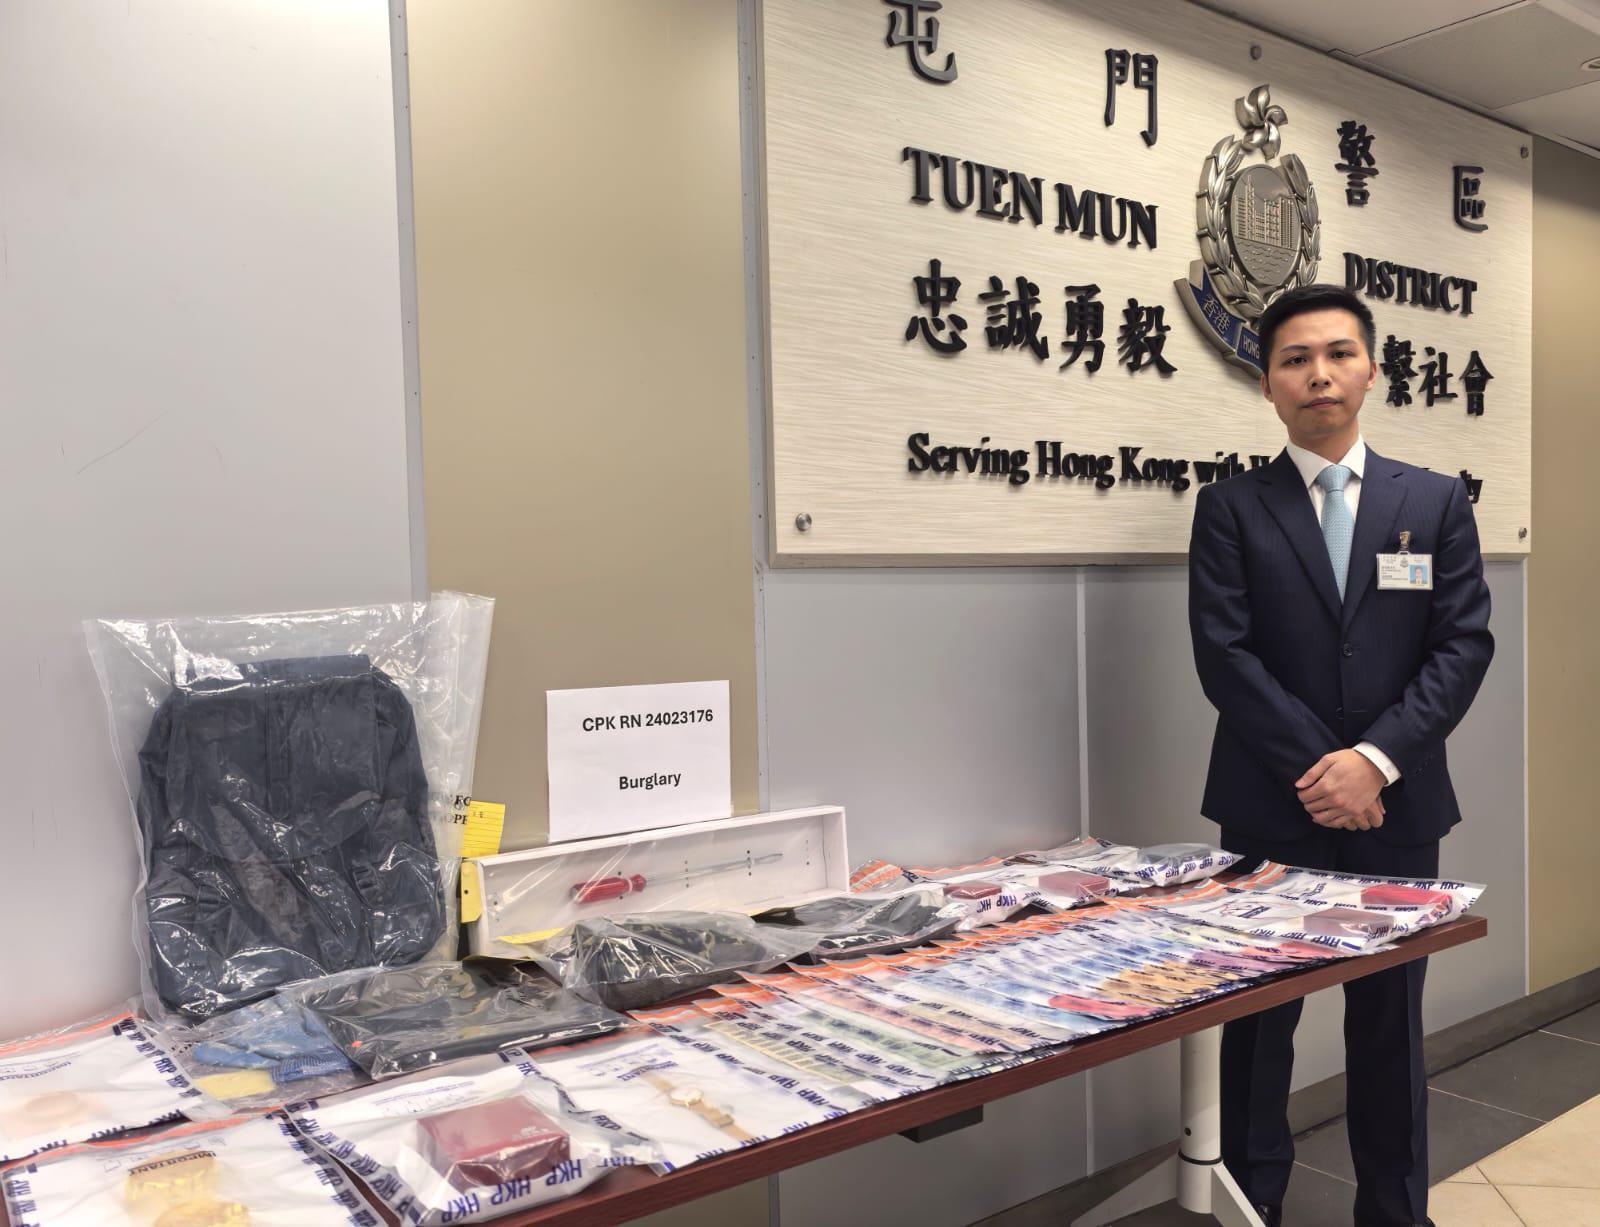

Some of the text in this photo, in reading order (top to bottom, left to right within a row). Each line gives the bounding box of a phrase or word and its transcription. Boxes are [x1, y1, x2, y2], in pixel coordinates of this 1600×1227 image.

[902, 146, 1478, 315] TUEN MUN DISTRICT
[905, 258, 1178, 374] 忠誠勇毅
[1243, 334, 1261, 360] HONG
[907, 432, 1030, 486] Serving
[1035, 440, 1116, 490] Hong
[1118, 446, 1191, 492] Kong
[582, 709, 714, 732] CPK RN 24023176
[619, 773, 682, 790] Burglary
[996, 894, 1017, 907] HKP
[441, 1192, 480, 1223] HKP
[490, 1175, 531, 1206] HKP
[545, 1158, 582, 1187] HKP
